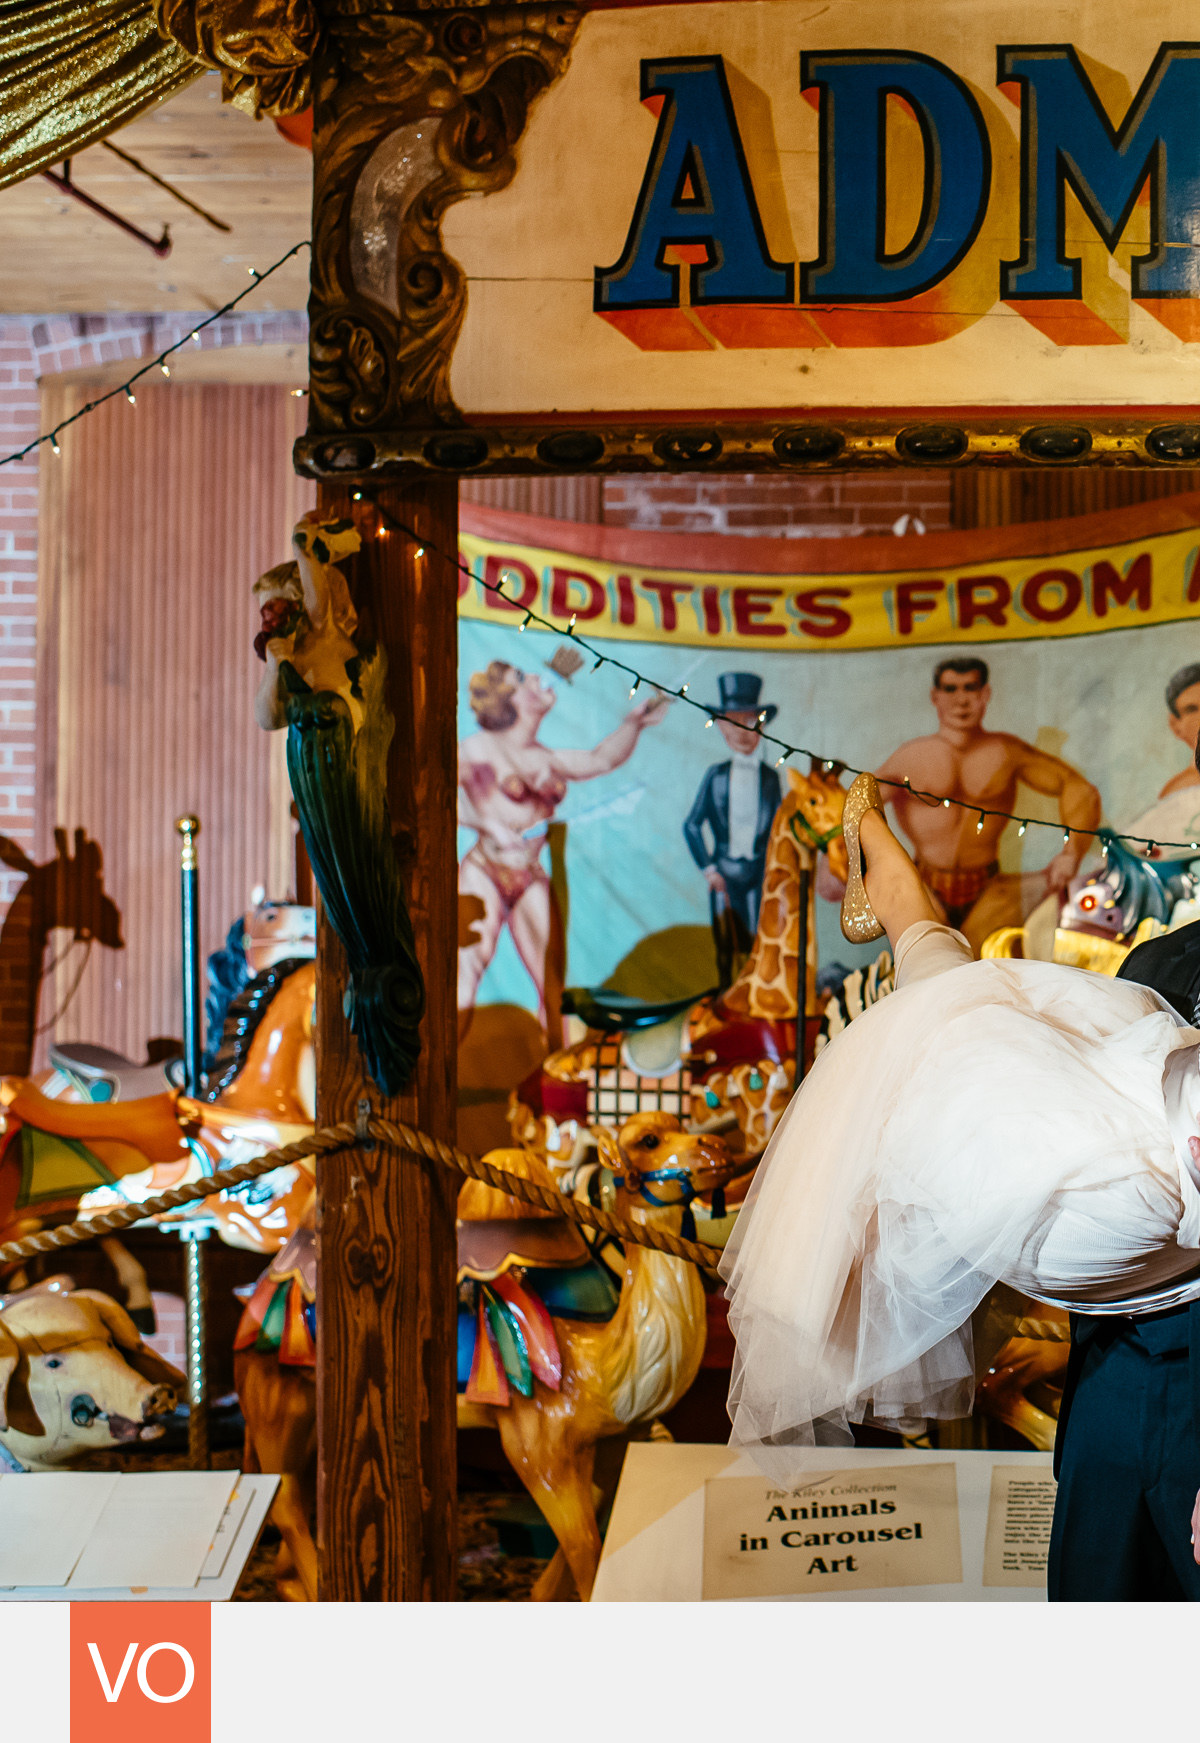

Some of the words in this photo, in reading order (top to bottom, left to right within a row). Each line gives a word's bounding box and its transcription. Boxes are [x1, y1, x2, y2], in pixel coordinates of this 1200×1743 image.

[459, 553, 851, 638] DDITIES
[896, 553, 1152, 636] FROM
[792, 1486, 826, 1500] Kiley
[830, 1482, 897, 1497] Collection
[767, 1498, 896, 1523] Animals
[740, 1533, 768, 1552] in
[781, 1522, 923, 1549] Carousel
[808, 1555, 858, 1575] Art
